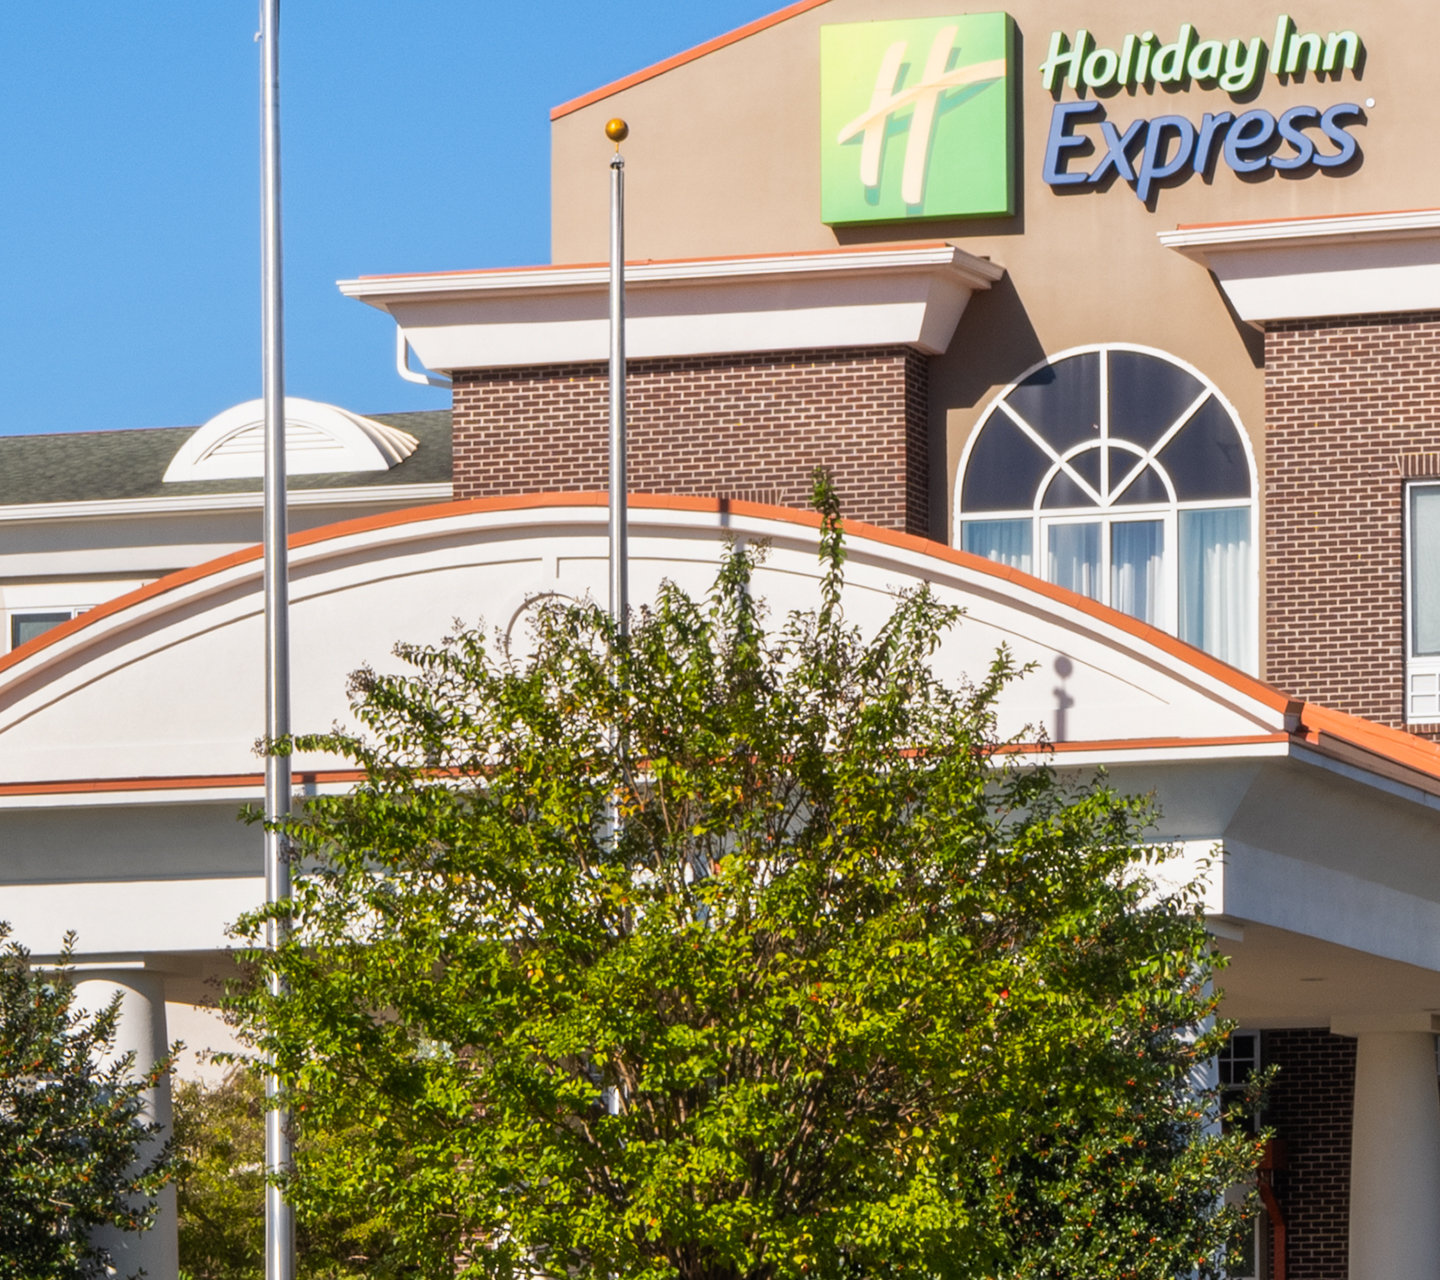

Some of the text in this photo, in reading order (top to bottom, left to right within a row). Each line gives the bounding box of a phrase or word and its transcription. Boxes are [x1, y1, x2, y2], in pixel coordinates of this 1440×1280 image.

[1039, 14, 1360, 93] Holiday Inn
[837, 25, 1007, 205] H
[1041, 100, 1361, 203] Express
